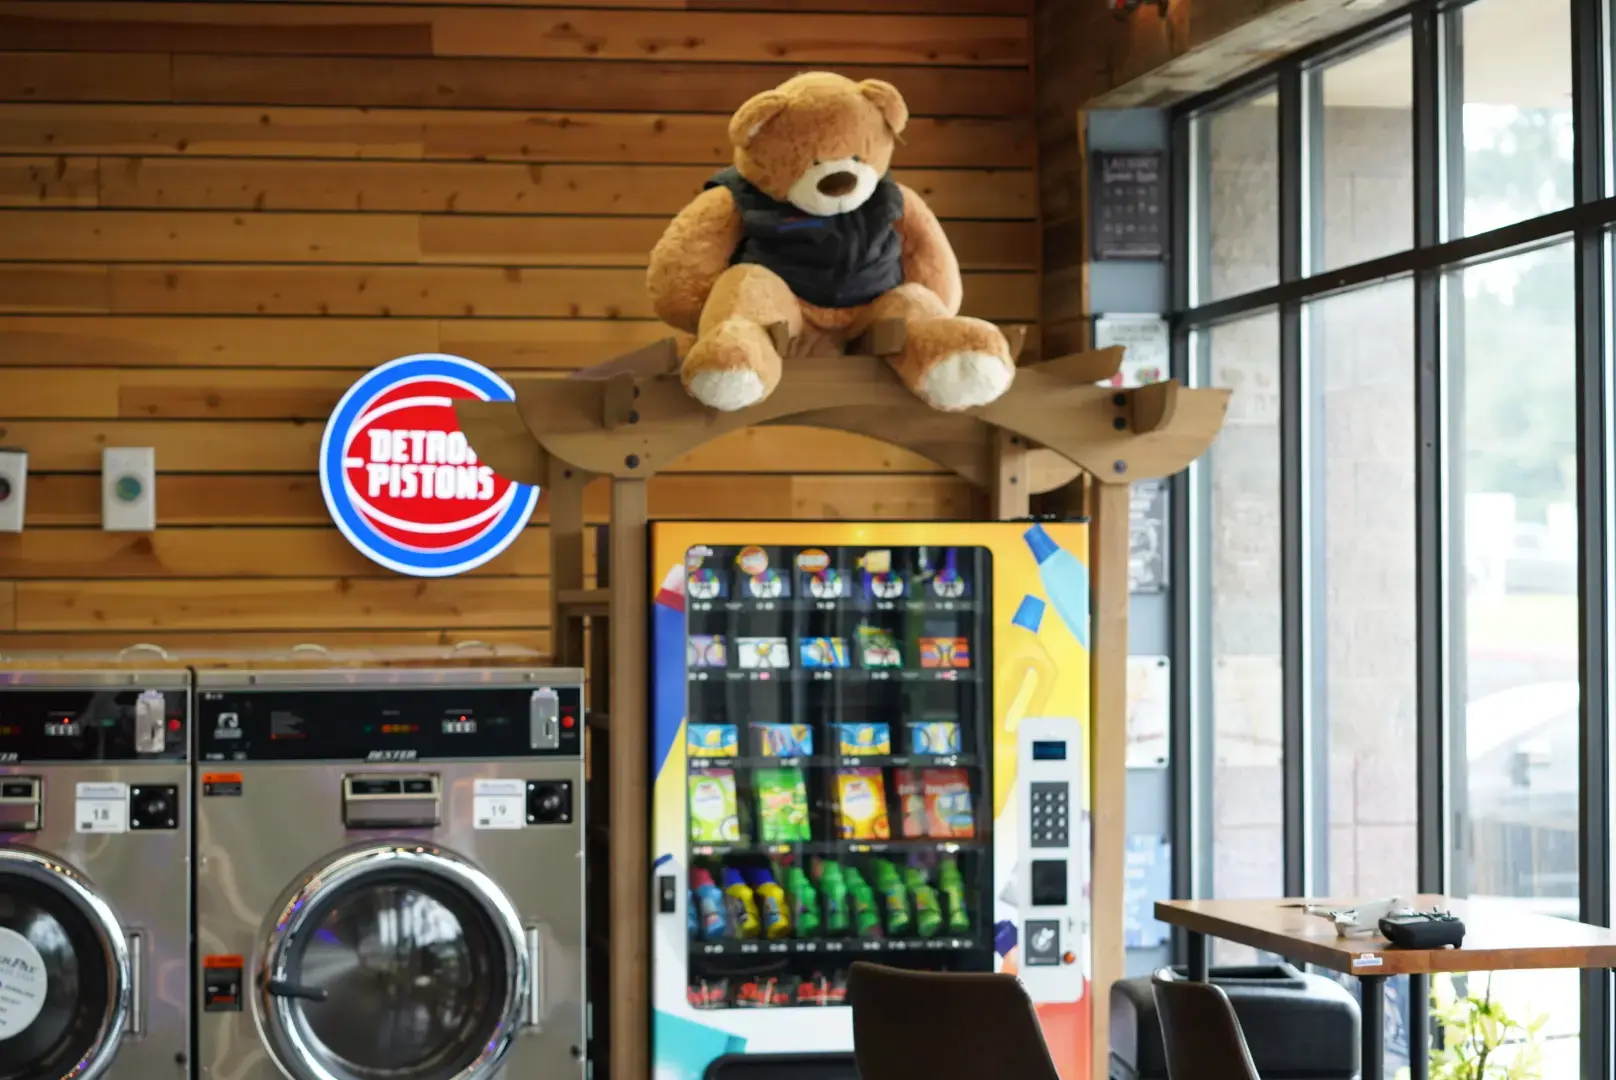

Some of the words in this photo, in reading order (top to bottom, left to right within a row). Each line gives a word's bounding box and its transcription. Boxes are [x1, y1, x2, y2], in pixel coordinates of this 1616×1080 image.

[367, 428, 478, 465] DETRO
[365, 462, 495, 500] PISTONS
[93, 808, 110, 821] 18
[491, 805, 507, 817] 19
